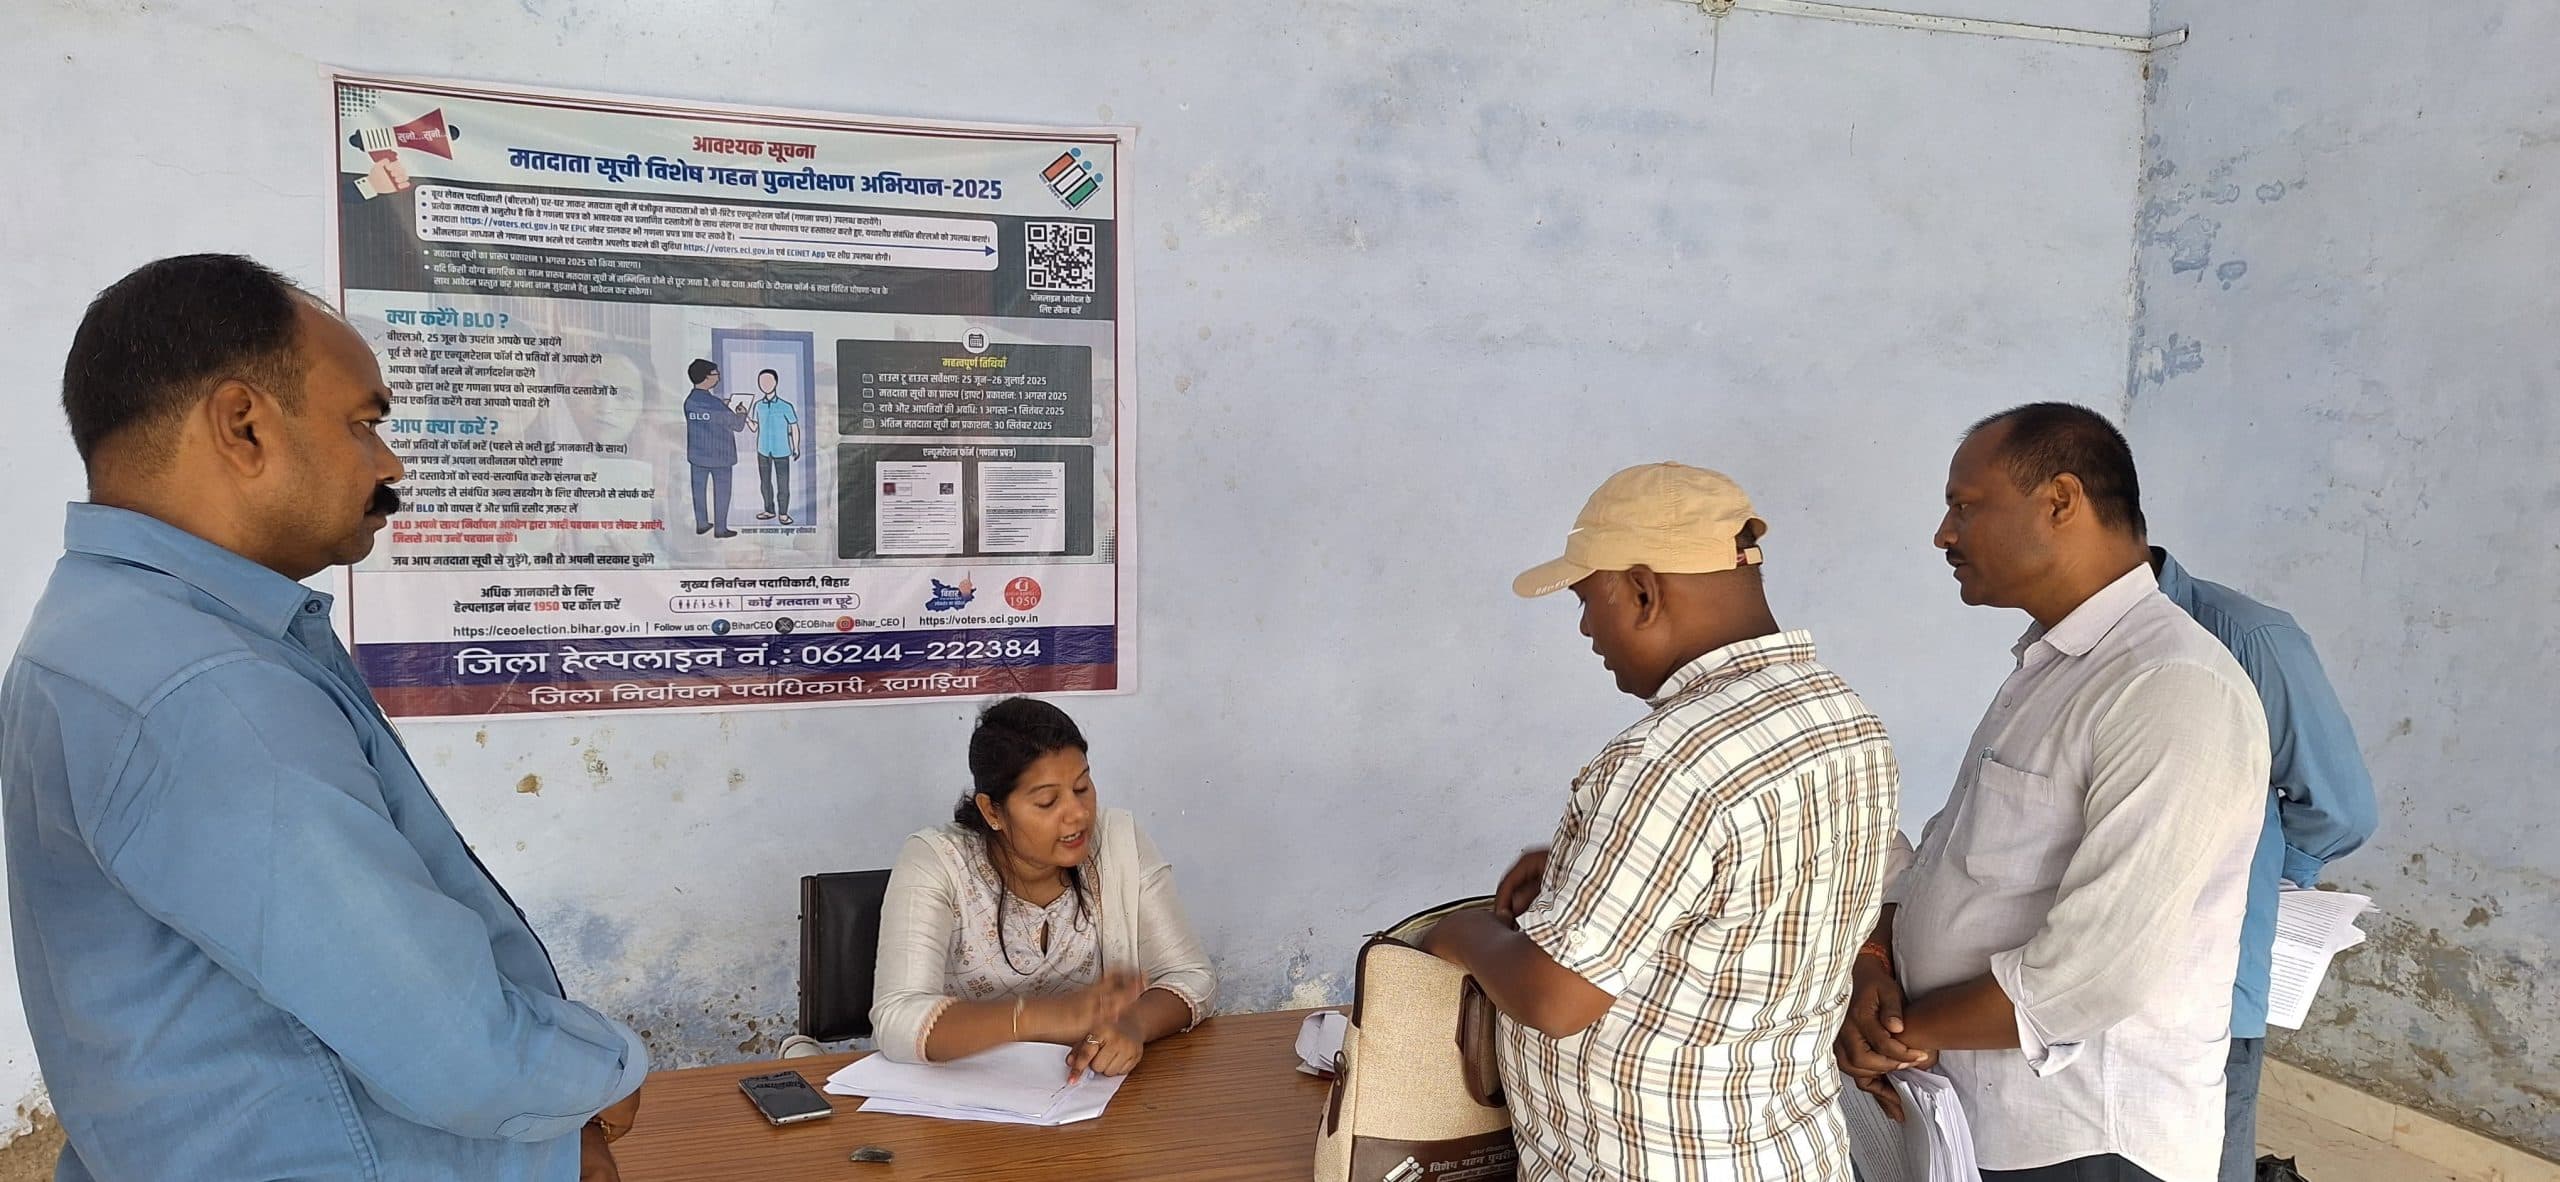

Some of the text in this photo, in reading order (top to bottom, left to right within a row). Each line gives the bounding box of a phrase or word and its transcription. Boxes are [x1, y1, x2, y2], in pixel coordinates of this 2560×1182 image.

[692, 136, 817, 162] आवश्यक सूचना
[507, 148, 1001, 199] मतदाता सूची विशेष गहन पुनरीक्षण अभियान-2025
[384, 309, 508, 329] क्या करेंगे BLO ?
[426, 333, 439, 342] 25
[388, 364, 536, 377] आपका फॉर्म भरने में मार्गदर्शन करेंगे
[961, 374, 972, 384] 25
[1026, 376, 1046, 385] 2025
[1018, 390, 1022, 400] 1
[1047, 391, 1067, 400] 2025
[689, 412, 711, 421] BLO
[390, 418, 498, 435] आप क्या करें ?
[994, 420, 1004, 429] 30
[1032, 420, 1052, 430] 2025
[389, 439, 627, 454] दोनों प्रतियों में फॉर्म भरें (पहले से भरी हुई जानकारी के साथ)
[391, 552, 654, 568] जब आप मतदाता सूची से जुड़ेंगे, तभी तो अपनी सरकार चुनेंगे
[480, 584, 595, 598] अधिक जानकारी के लिए
[679, 576, 850, 592] मुख्य निर्वाचन पदाधिकारी, बिहार
[453, 597, 621, 613] हेल्पलाइन नंबर 1950 पर कॉल करें
[747, 595, 855, 610] कोई मतदाता न छूटे
[1009, 596, 1038, 607] 1950
[653, 622, 682, 631] Follow
[696, 623, 710, 631] on:
[731, 621, 774, 631] BiharCEO
[794, 619, 835, 629] CEOBihar
[854, 617, 900, 629] Bihar_CEO
[919, 613, 1039, 628] https://voters.eci.gov.in
[453, 624, 640, 639] https://ceoelection.bihar.gov.in
[452, 647, 550, 674] जिला
[557, 646, 726, 672] हेल्पलाइन
[527, 672, 979, 704] जिला निर्वाचन पदाधिकारी, खगड़िया
